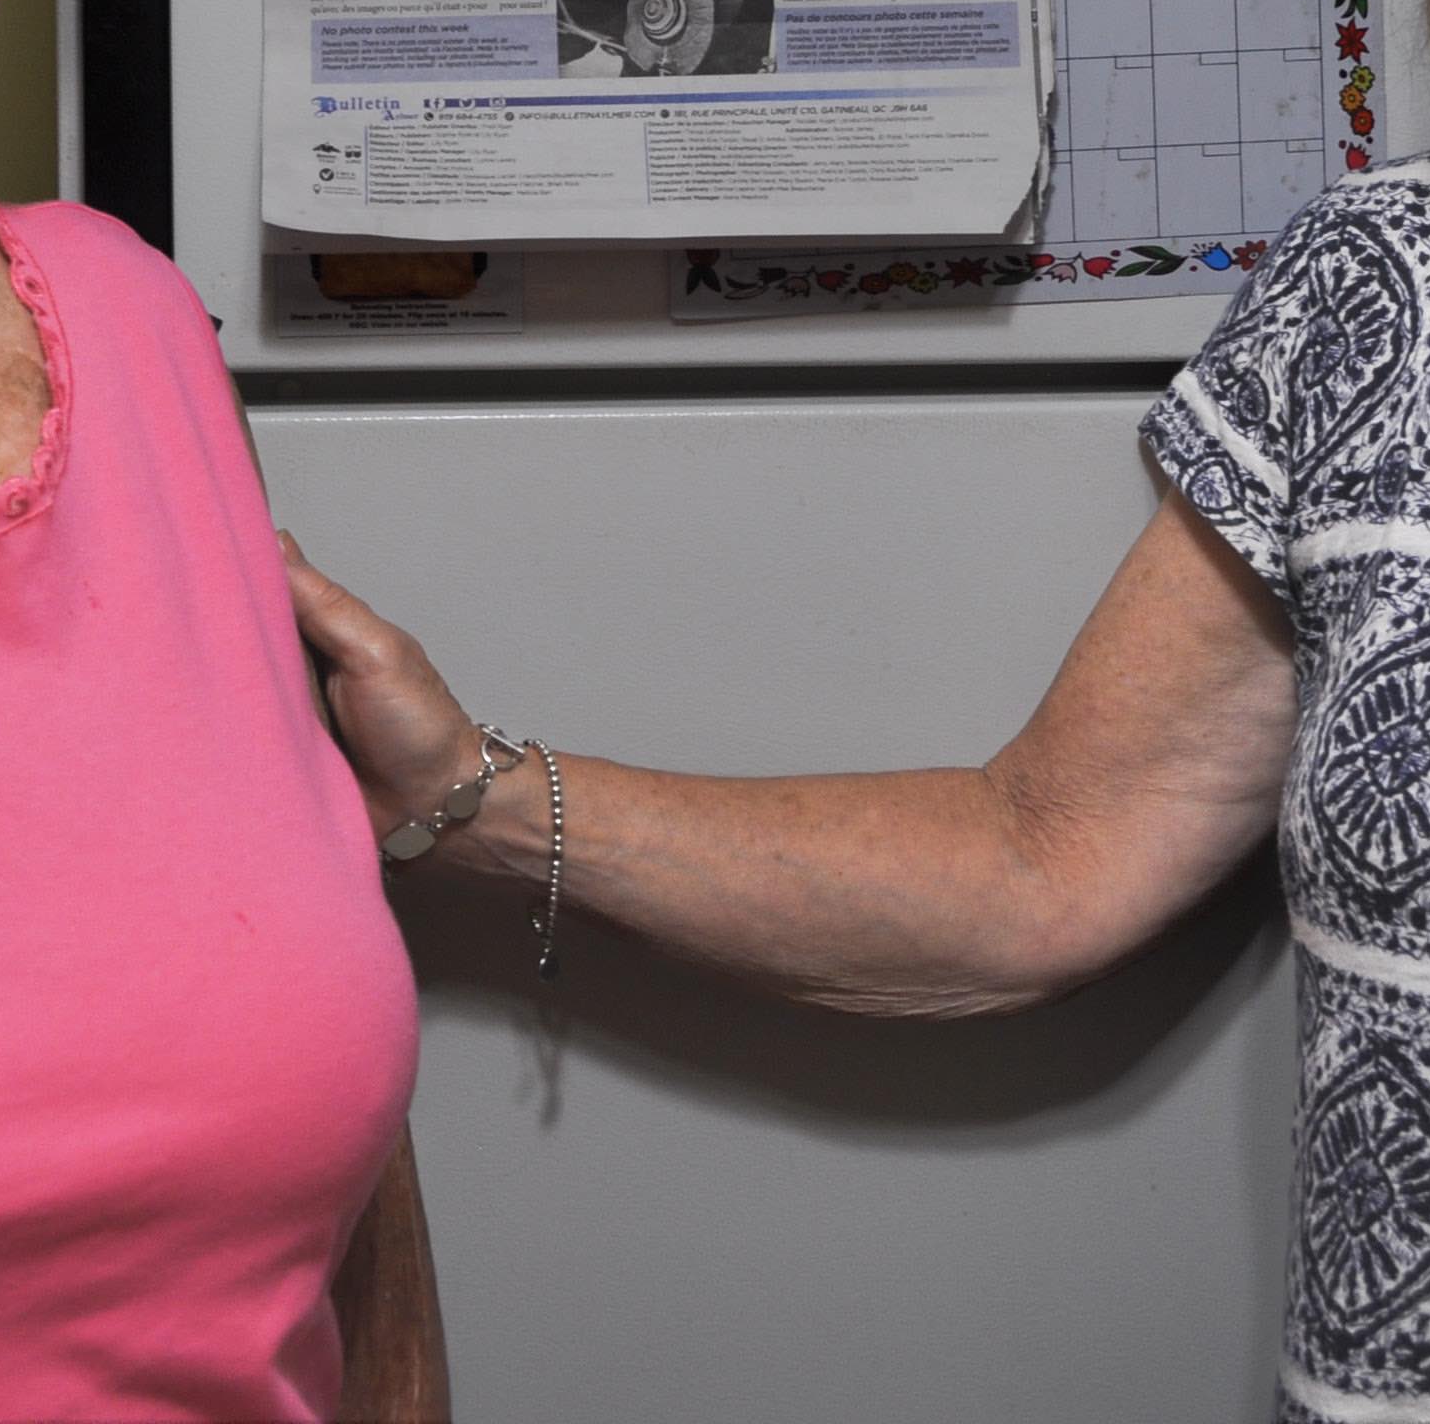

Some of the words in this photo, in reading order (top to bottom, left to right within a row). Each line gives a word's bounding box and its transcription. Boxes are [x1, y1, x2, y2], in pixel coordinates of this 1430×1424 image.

[785, 13, 804, 23] Pas
[806, 13, 821, 22] de
[823, 14, 872, 22] concours
[874, 11, 906, 22] photo
[909, 10, 937, 20] cette
[939, 9, 984, 19] semaine
[321, 25, 337, 35] No
[339, 25, 372, 36] photo
[374, 24, 415, 34] contest
[418, 24, 437, 33] this
[440, 24, 469, 33] week
[310, 96, 401, 118] Bulletin
[690, 108, 709, 117] RUE
[711, 107, 767, 117] PRINCIPALE,
[770, 106, 797, 116] UNITÉ
[800, 106, 817, 115] C10,
[820, 105, 868, 114] GATINEAU,
[872, 105, 885, 113] QC
